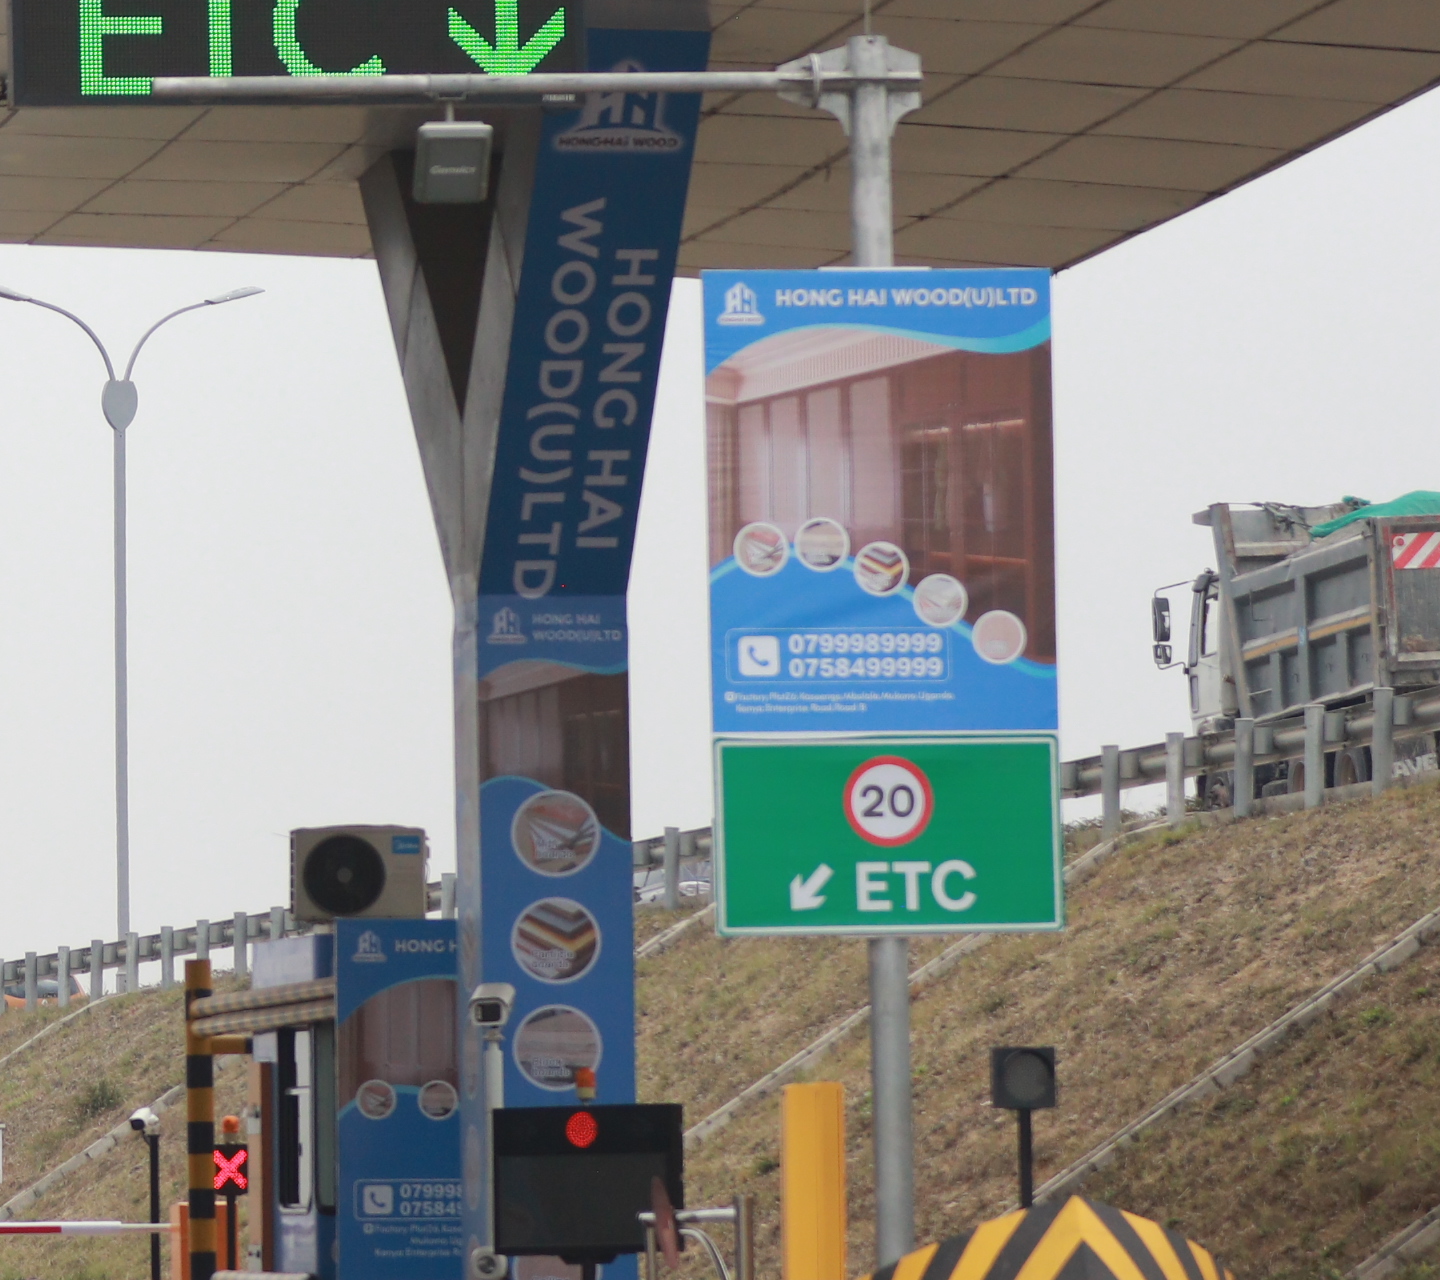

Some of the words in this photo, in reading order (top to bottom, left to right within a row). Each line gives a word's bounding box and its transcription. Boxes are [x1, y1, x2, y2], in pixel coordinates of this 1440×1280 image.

[632, 136, 679, 148] WOOD
[775, 288, 844, 307] HONG
[848, 288, 888, 307] HAI
[891, 287, 1038, 309] WOOD(U)LTD
[592, 248, 659, 430] HONG
[512, 195, 607, 601] WOOD(U)LTD
[575, 449, 632, 549] HAI
[532, 613, 573, 625] HONG
[575, 613, 601, 624] HAI
[787, 633, 943, 654] 0799989999
[788, 657, 944, 678] 0758499999
[860, 784, 915, 818] 20
[855, 859, 978, 912] ETC
[394, 939, 445, 953] HONG
